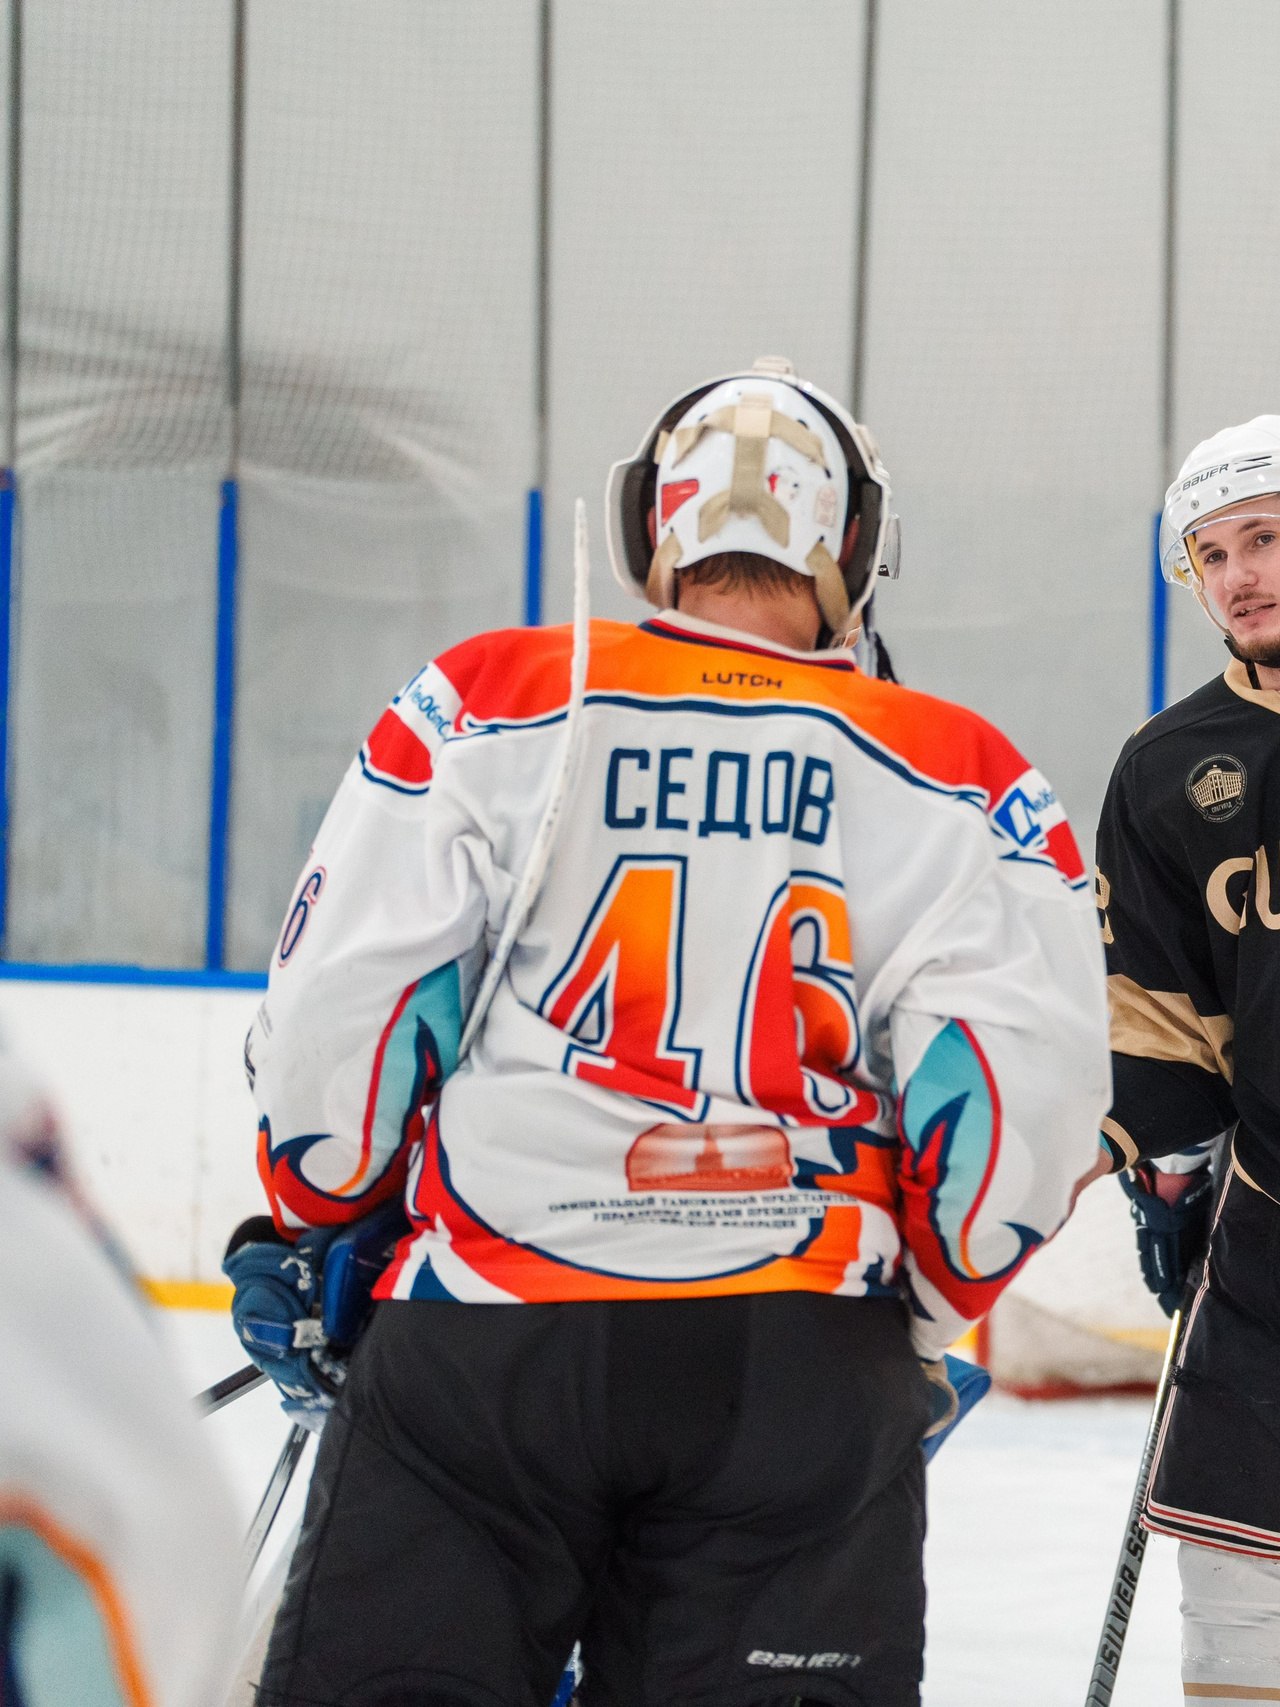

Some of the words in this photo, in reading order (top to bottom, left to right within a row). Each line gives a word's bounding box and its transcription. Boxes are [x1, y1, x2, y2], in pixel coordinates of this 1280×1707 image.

[1182, 463, 1229, 492] BAUER
[702, 672, 783, 689] LUTCH
[604, 747, 834, 847] СЕДОВ
[538, 854, 882, 1128] 46
[1100, 1564, 1139, 1673] SILVER
